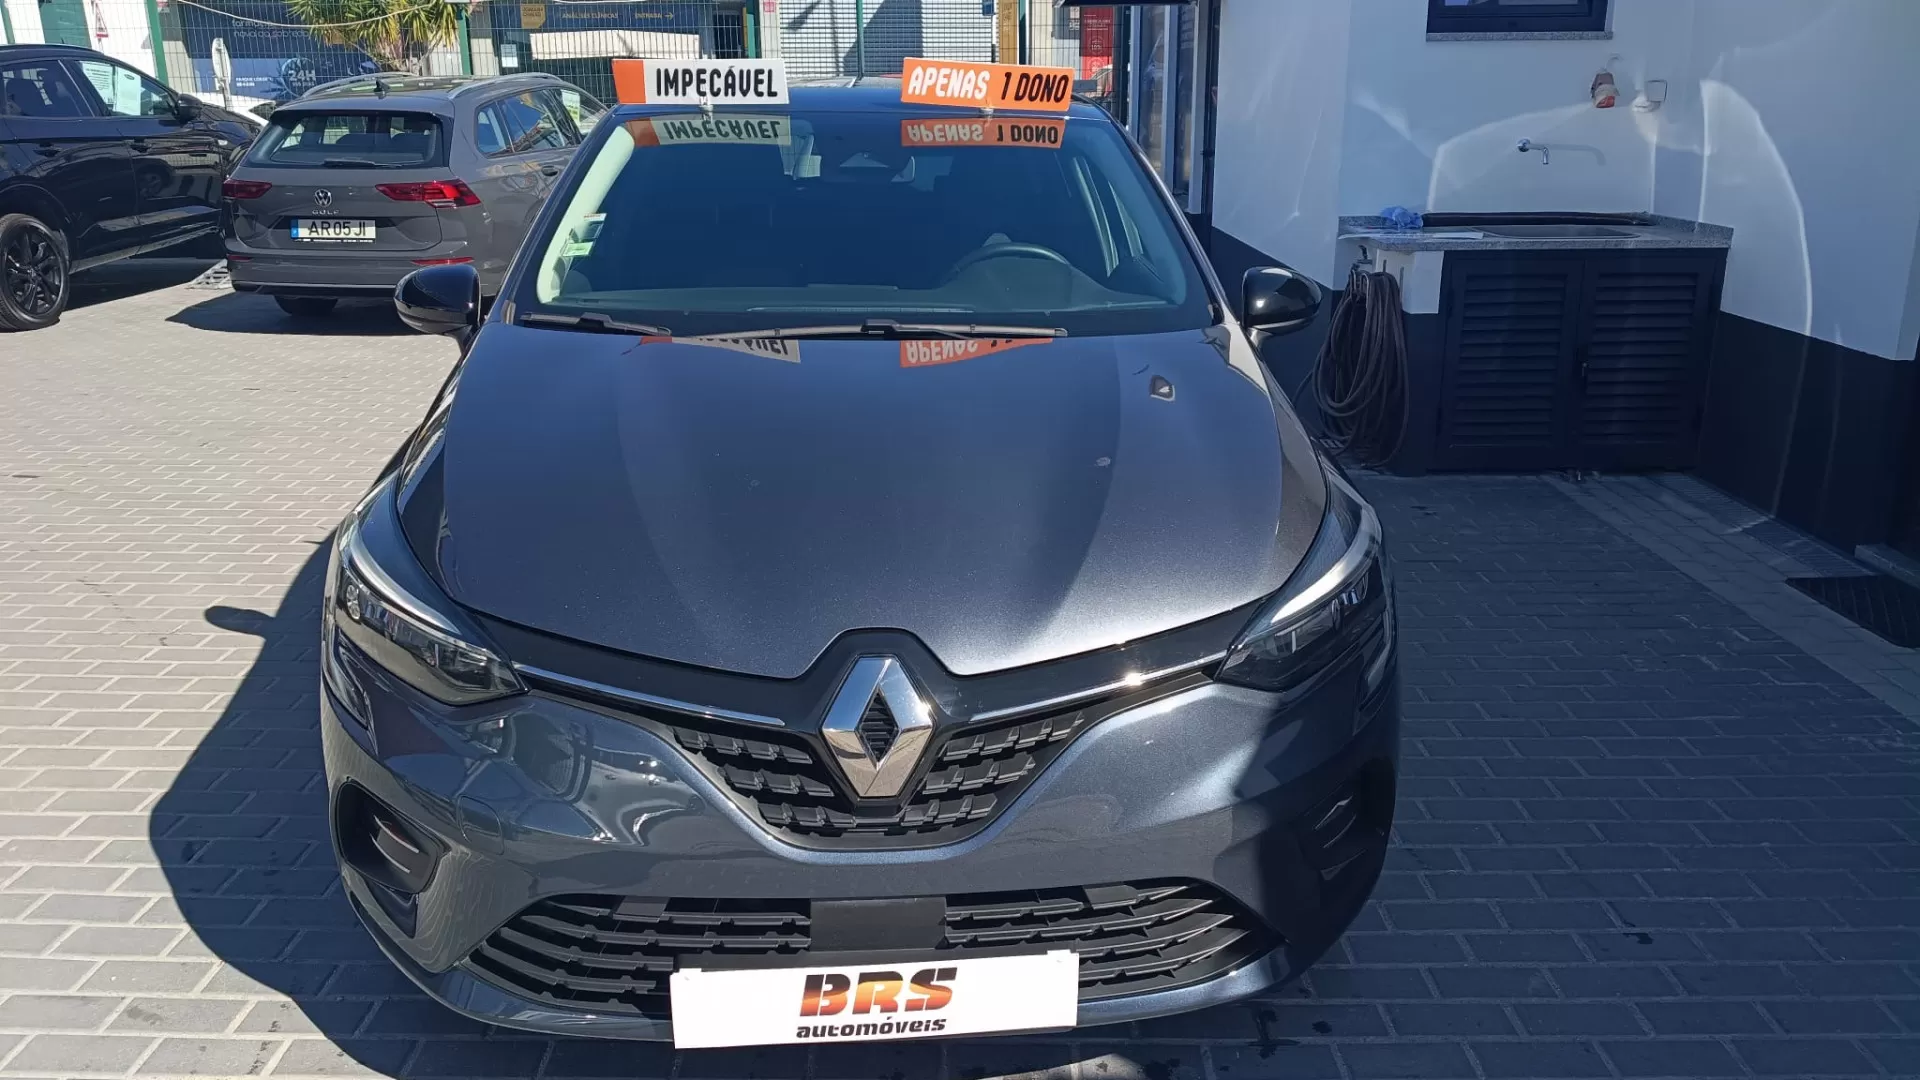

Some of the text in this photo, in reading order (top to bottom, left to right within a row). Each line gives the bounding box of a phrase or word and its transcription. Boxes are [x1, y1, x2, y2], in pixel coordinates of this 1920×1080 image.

[656, 66, 778, 98] IMPECÁVEL
[907, 65, 1069, 103] APENAS 1 DONO
[309, 221, 366, 237] AR 05 JI
[799, 967, 958, 1017] BRS
[796, 1016, 947, 1038] automóveis
